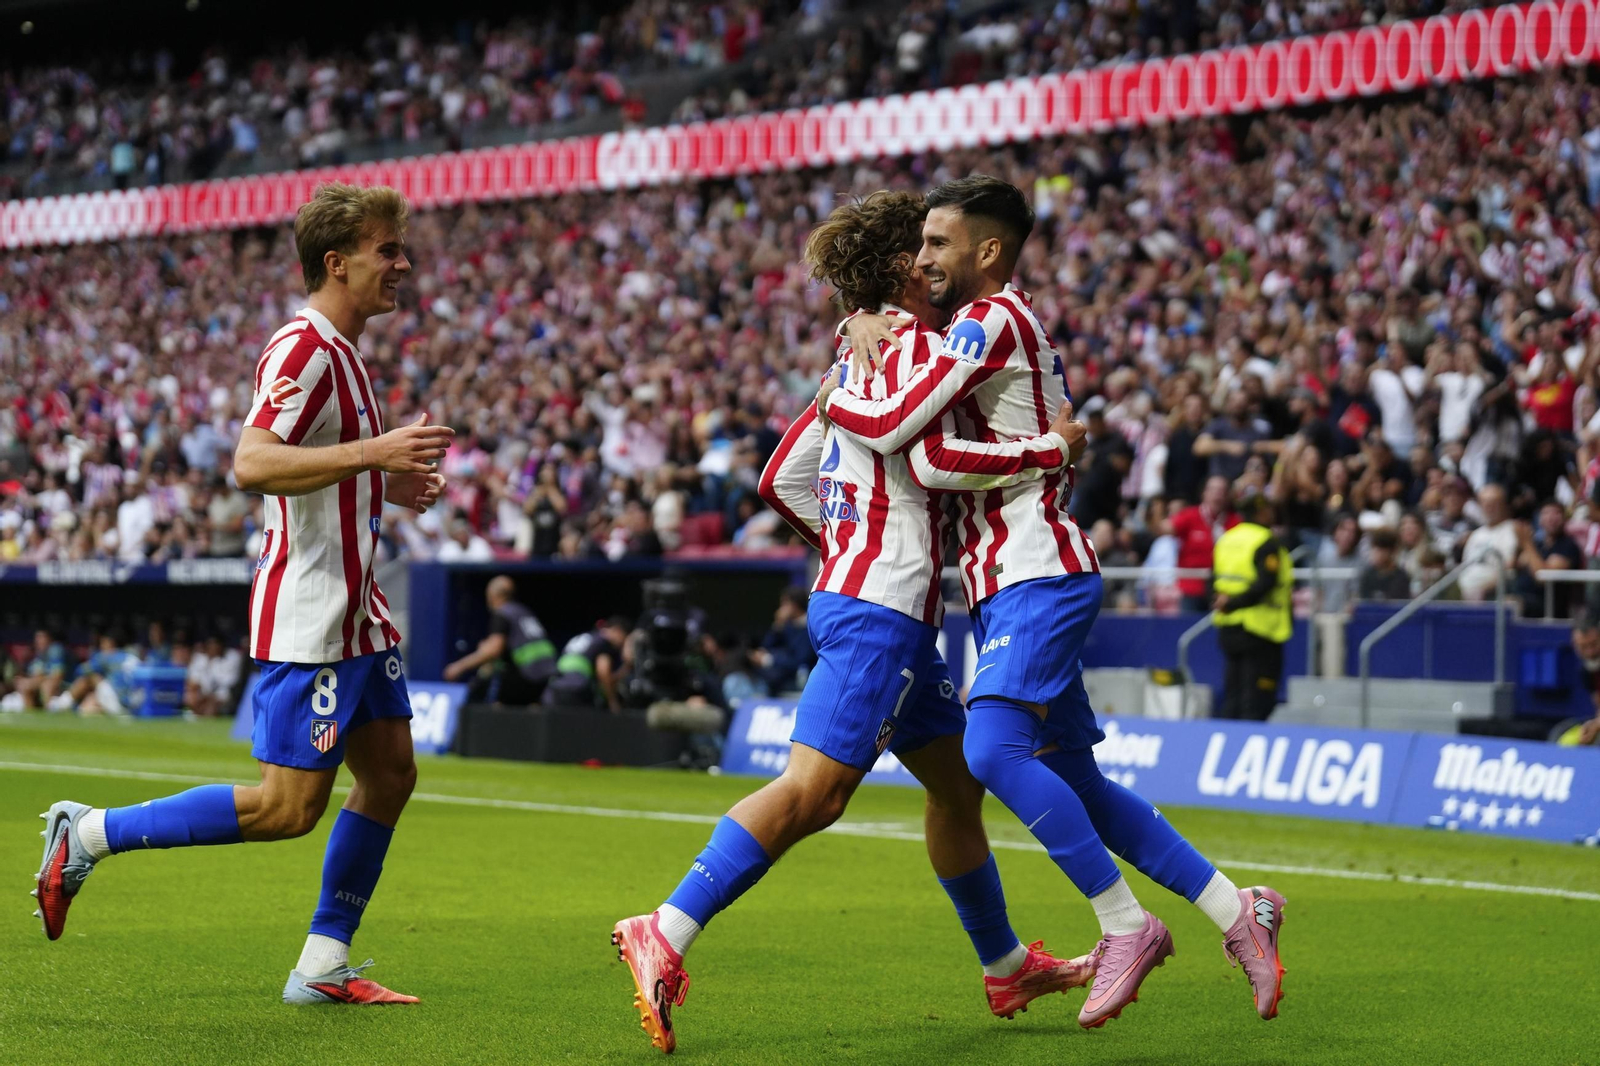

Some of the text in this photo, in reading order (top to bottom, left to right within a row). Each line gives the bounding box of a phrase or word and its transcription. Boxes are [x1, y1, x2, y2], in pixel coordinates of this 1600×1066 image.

[311, 667, 338, 716] 8
[893, 667, 915, 718] 7
[1197, 731, 1384, 809] LALIGA
[1433, 742, 1576, 803] Mahou
